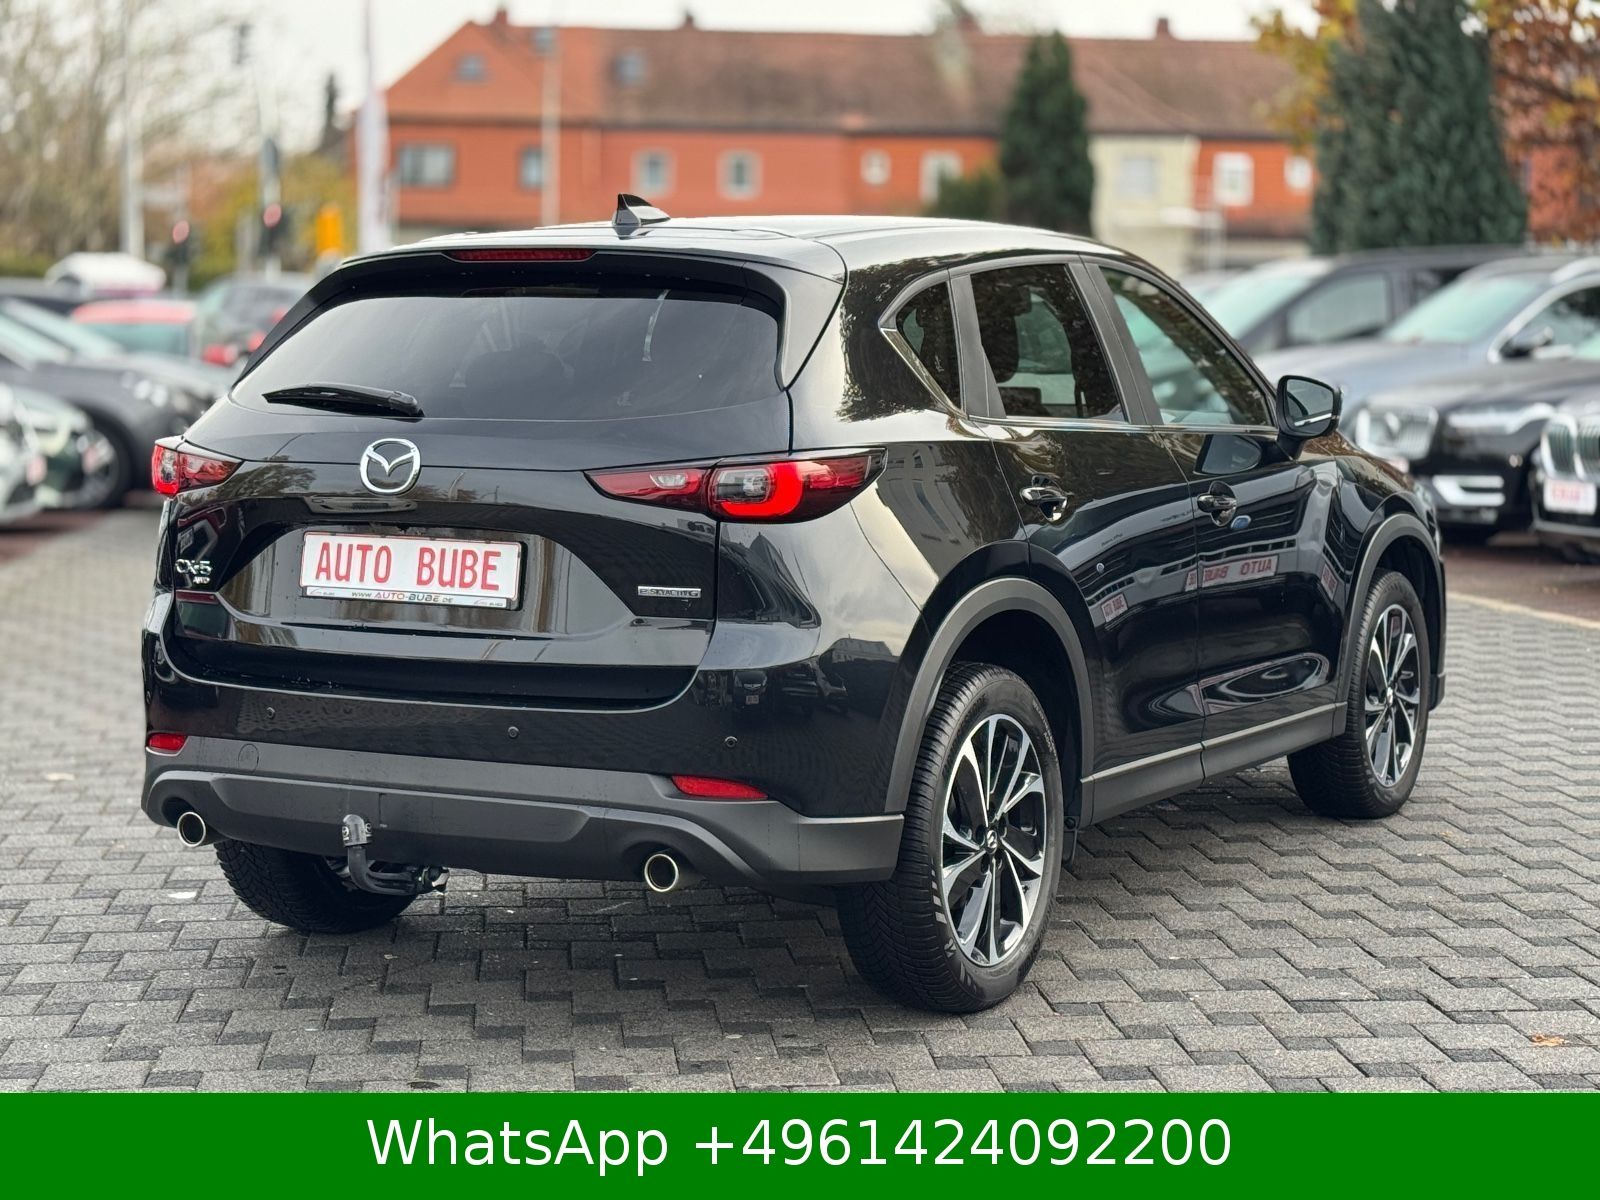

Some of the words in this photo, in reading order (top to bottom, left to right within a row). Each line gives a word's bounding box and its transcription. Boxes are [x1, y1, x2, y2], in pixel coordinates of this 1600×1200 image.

[175, 558, 212, 576] CX-5
[315, 541, 392, 584] AUTO
[416, 546, 502, 591] BUBE
